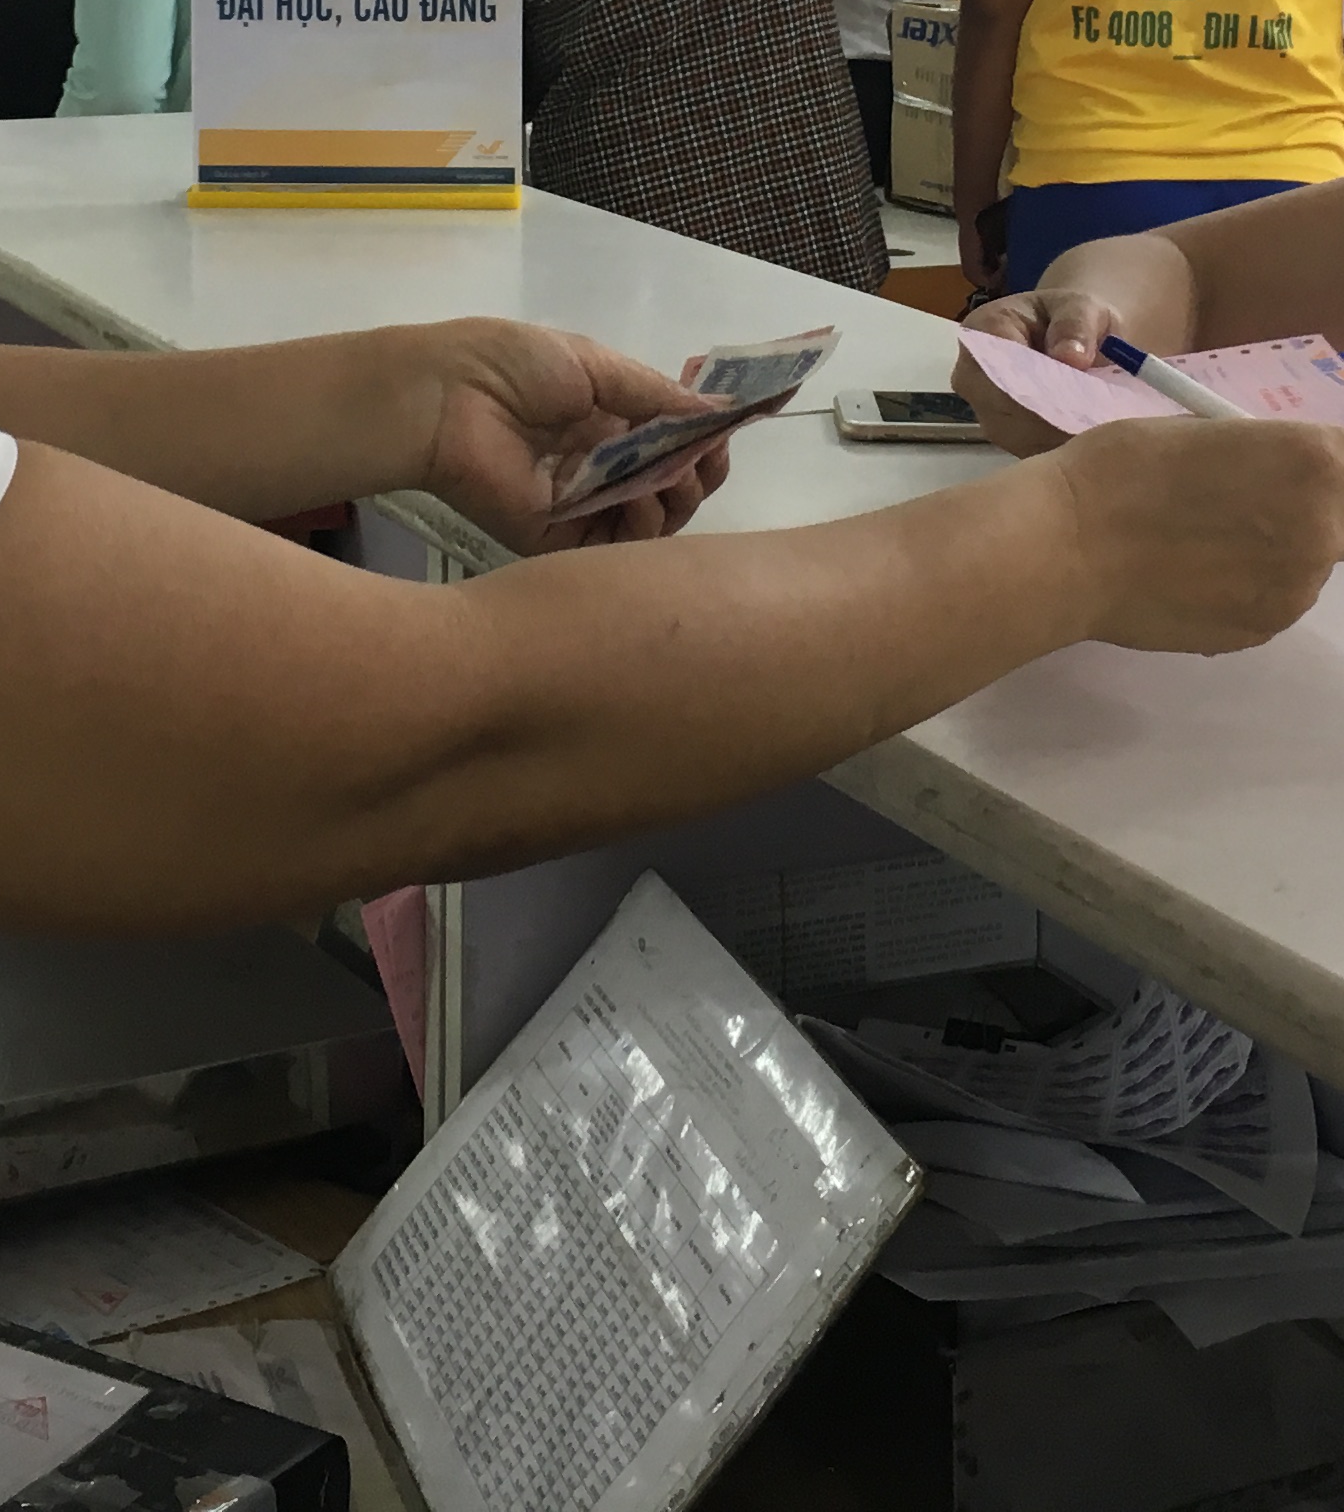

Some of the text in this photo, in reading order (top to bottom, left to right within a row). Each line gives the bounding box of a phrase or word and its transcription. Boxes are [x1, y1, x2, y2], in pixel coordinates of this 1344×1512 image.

[896, 16, 957, 48] xter
[1071, 5, 1100, 44] FC
[1108, 10, 1173, 48] 4008
[1203, 11, 1240, 50] ĐH
